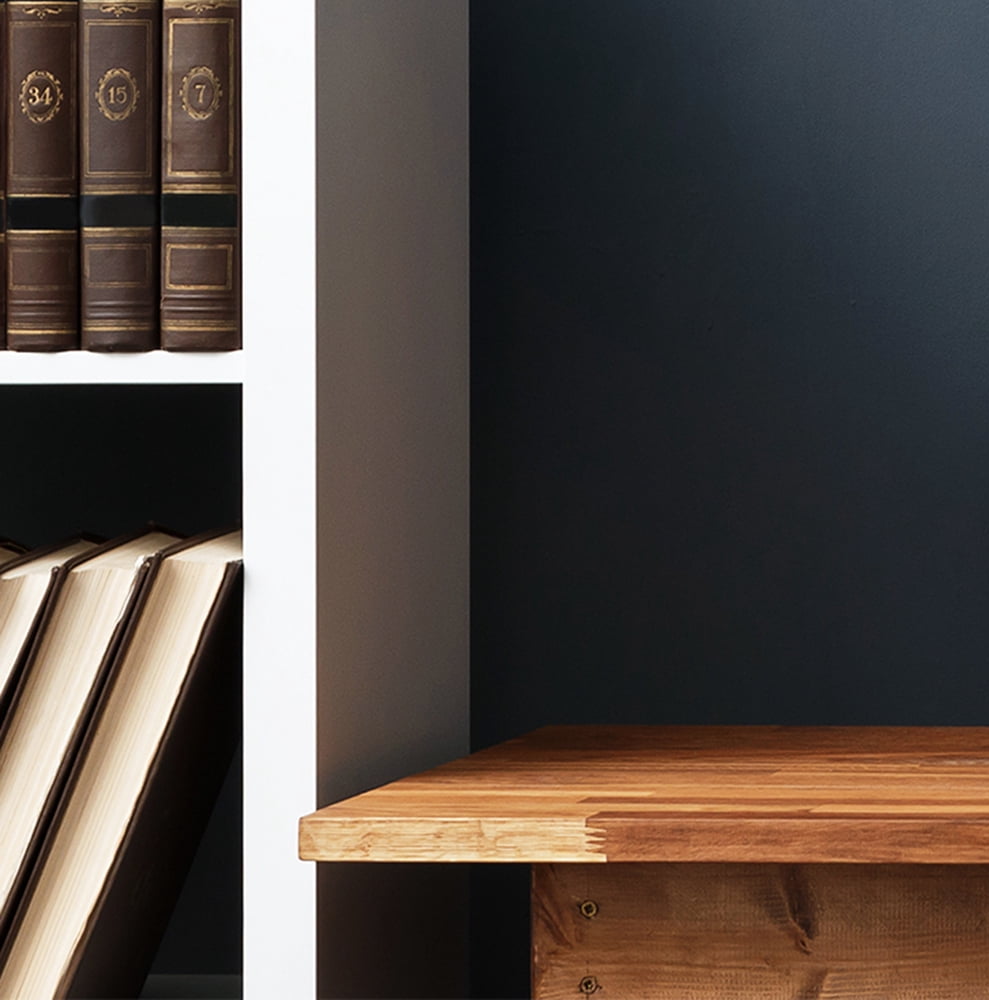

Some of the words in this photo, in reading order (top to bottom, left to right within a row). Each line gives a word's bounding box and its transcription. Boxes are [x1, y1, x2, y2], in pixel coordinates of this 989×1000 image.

[28, 86, 53, 106] 34
[107, 85, 128, 104] 15
[194, 84, 207, 104] 7
